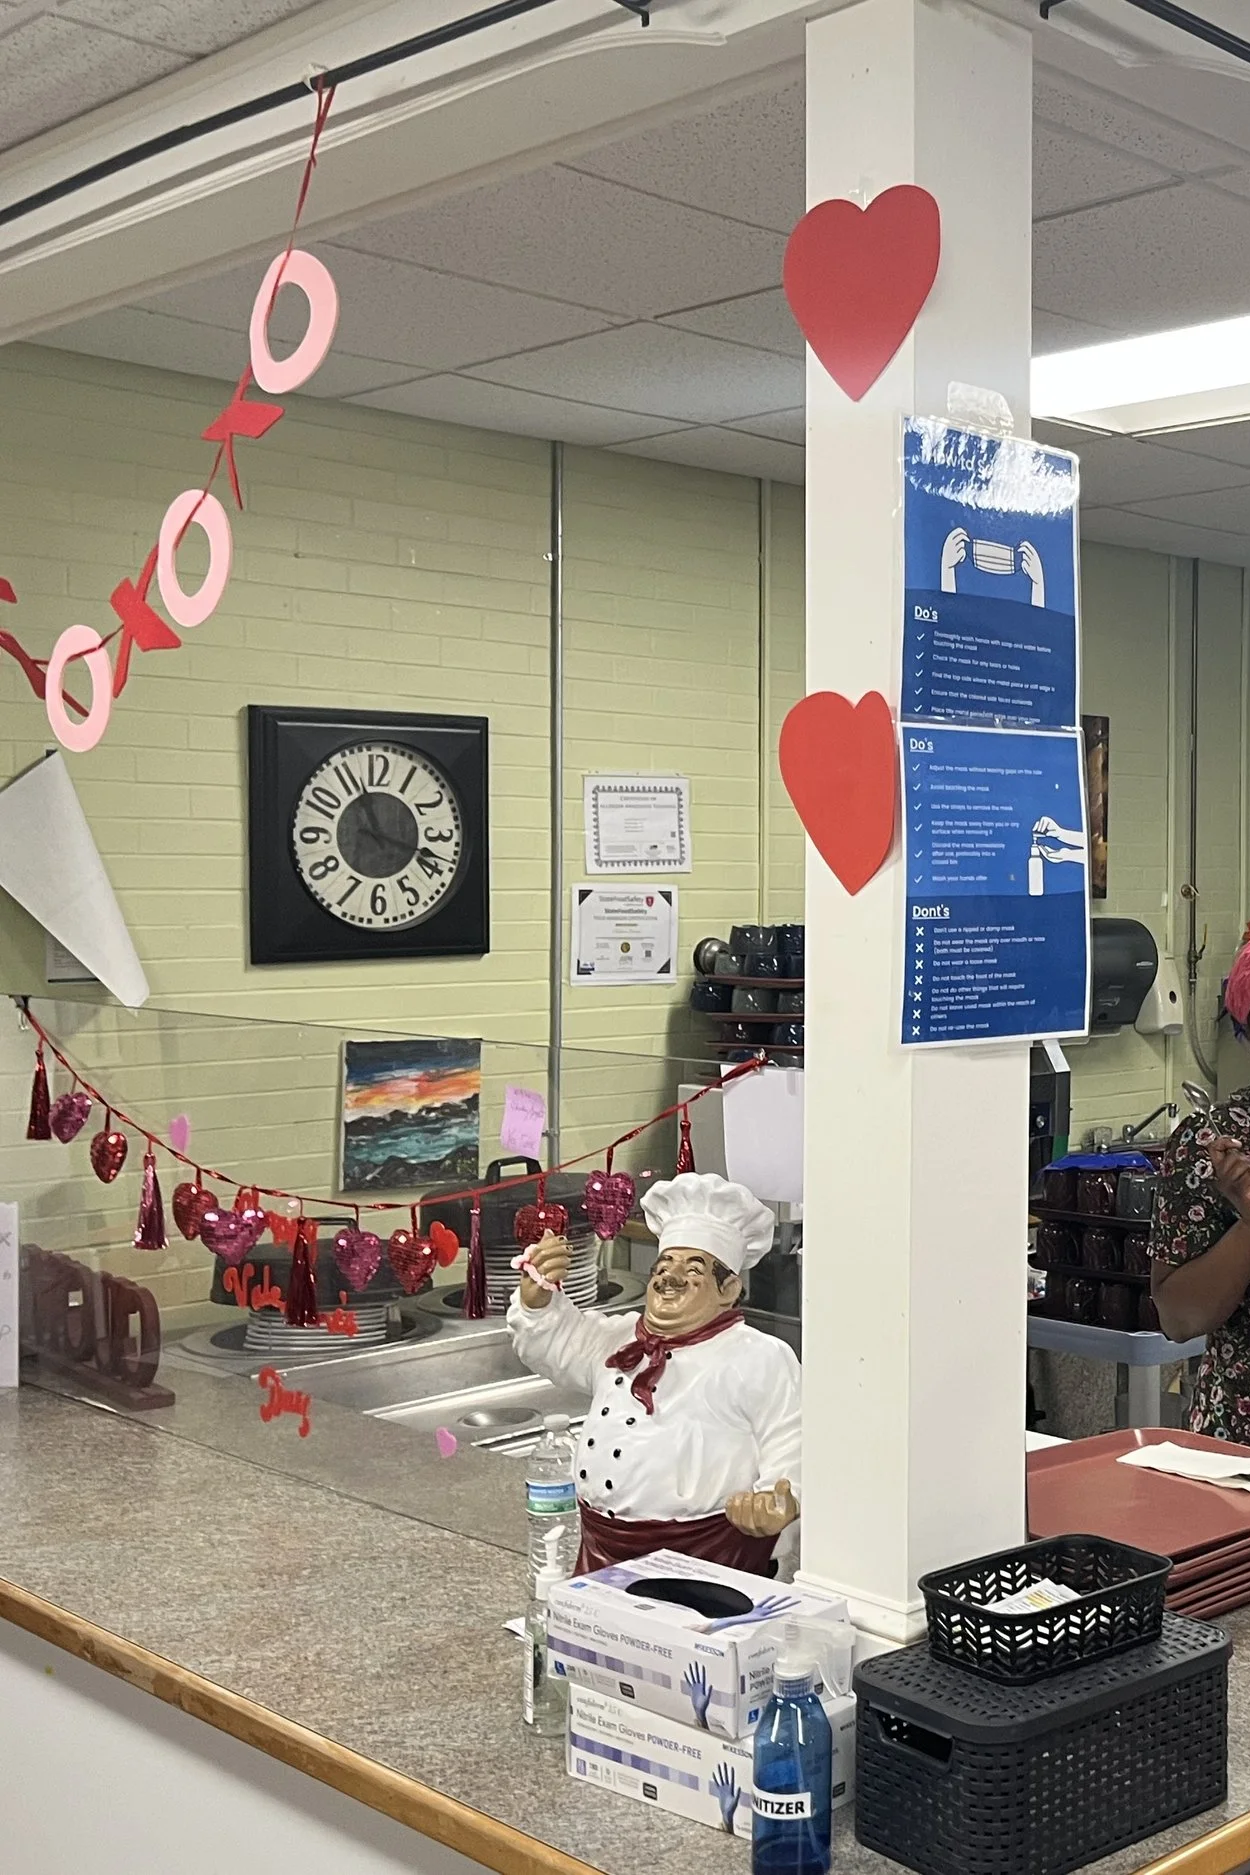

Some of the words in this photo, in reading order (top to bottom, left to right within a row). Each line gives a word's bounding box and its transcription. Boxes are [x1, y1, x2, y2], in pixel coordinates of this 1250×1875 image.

[914, 605, 938, 620] Do's
[910, 738, 934, 752] Do's
[333, 762, 361, 796] 11
[367, 754, 390, 787] 12
[398, 765, 417, 794] 1
[305, 787, 341, 820] 10
[415, 790, 443, 816] 2
[299, 826, 332, 845] 9
[424, 827, 454, 843] 3
[309, 855, 340, 881] 8
[335, 875, 362, 907] 7
[370, 884, 387, 916] 6
[397, 875, 420, 906] 5
[912, 905, 950, 918] Dont's
[553, 1611, 572, 1626] Nitrile
[573, 1618, 593, 1633] Exam
[593, 1625, 619, 1642] Gloves
[620, 1634, 673, 1660] POWDER-FREE
[576, 1708, 597, 1725] Nitrile
[598, 1716, 618, 1731] Exam
[619, 1723, 646, 1741] Gloves
[647, 1733, 702, 1761] POWDER-FREE
